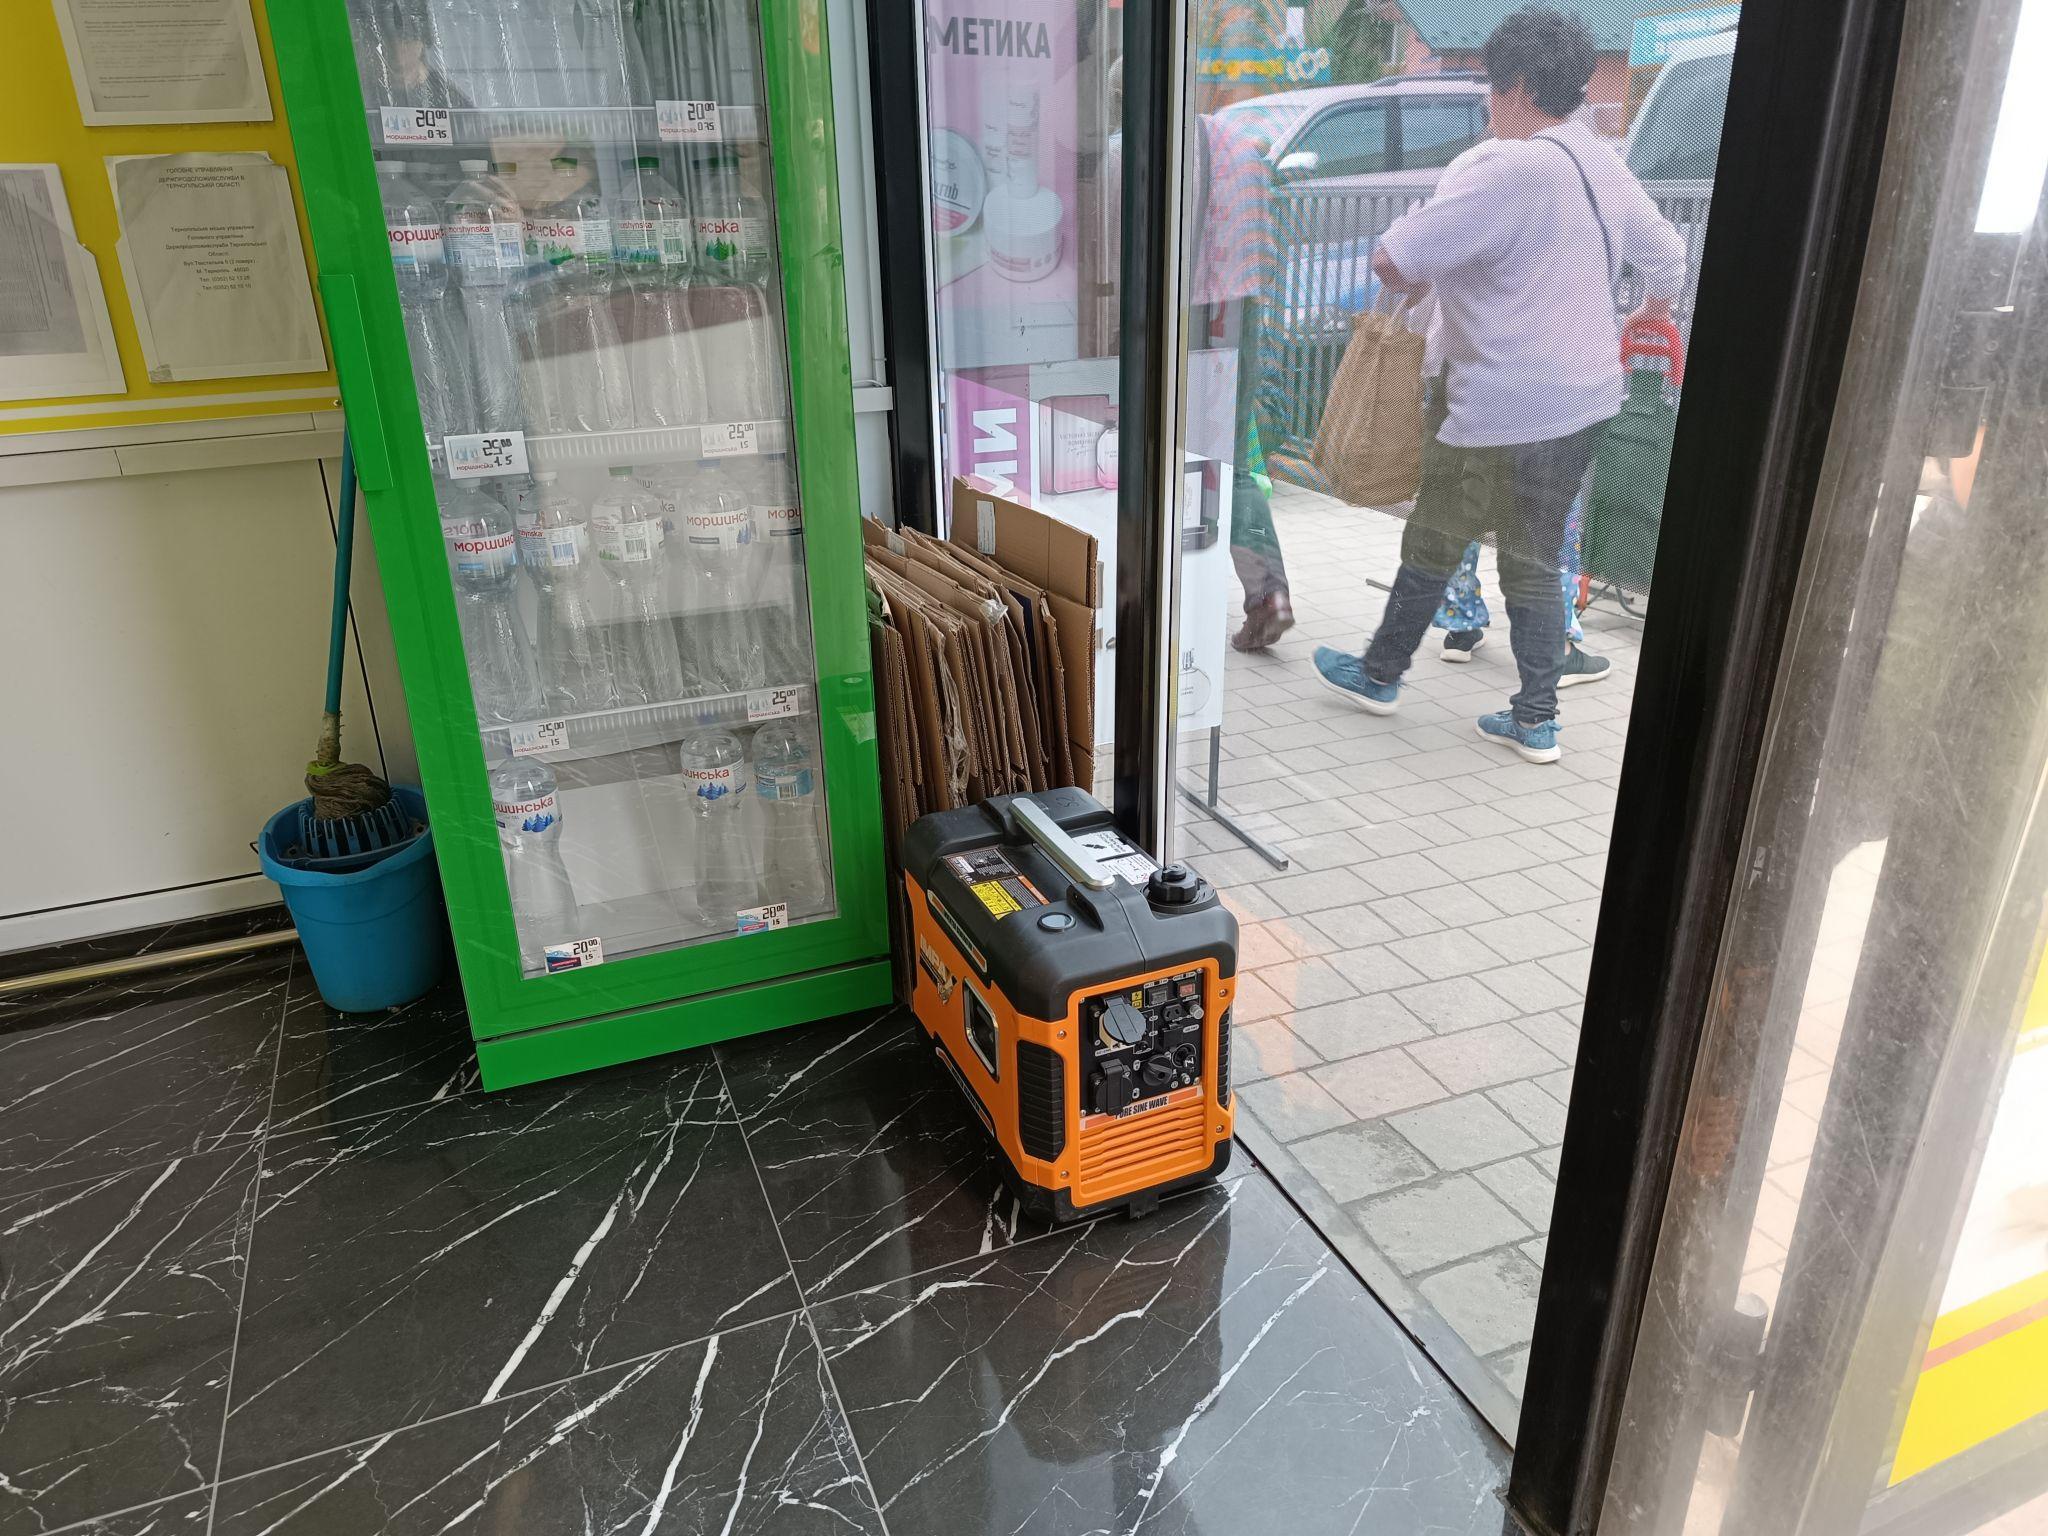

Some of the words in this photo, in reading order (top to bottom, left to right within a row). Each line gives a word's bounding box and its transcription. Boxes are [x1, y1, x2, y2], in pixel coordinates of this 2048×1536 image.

[929, 15, 1051, 59] МЕТИКА
[1133, 1103, 1148, 1115] SINE
[1149, 1096, 1168, 1110] WAVE
